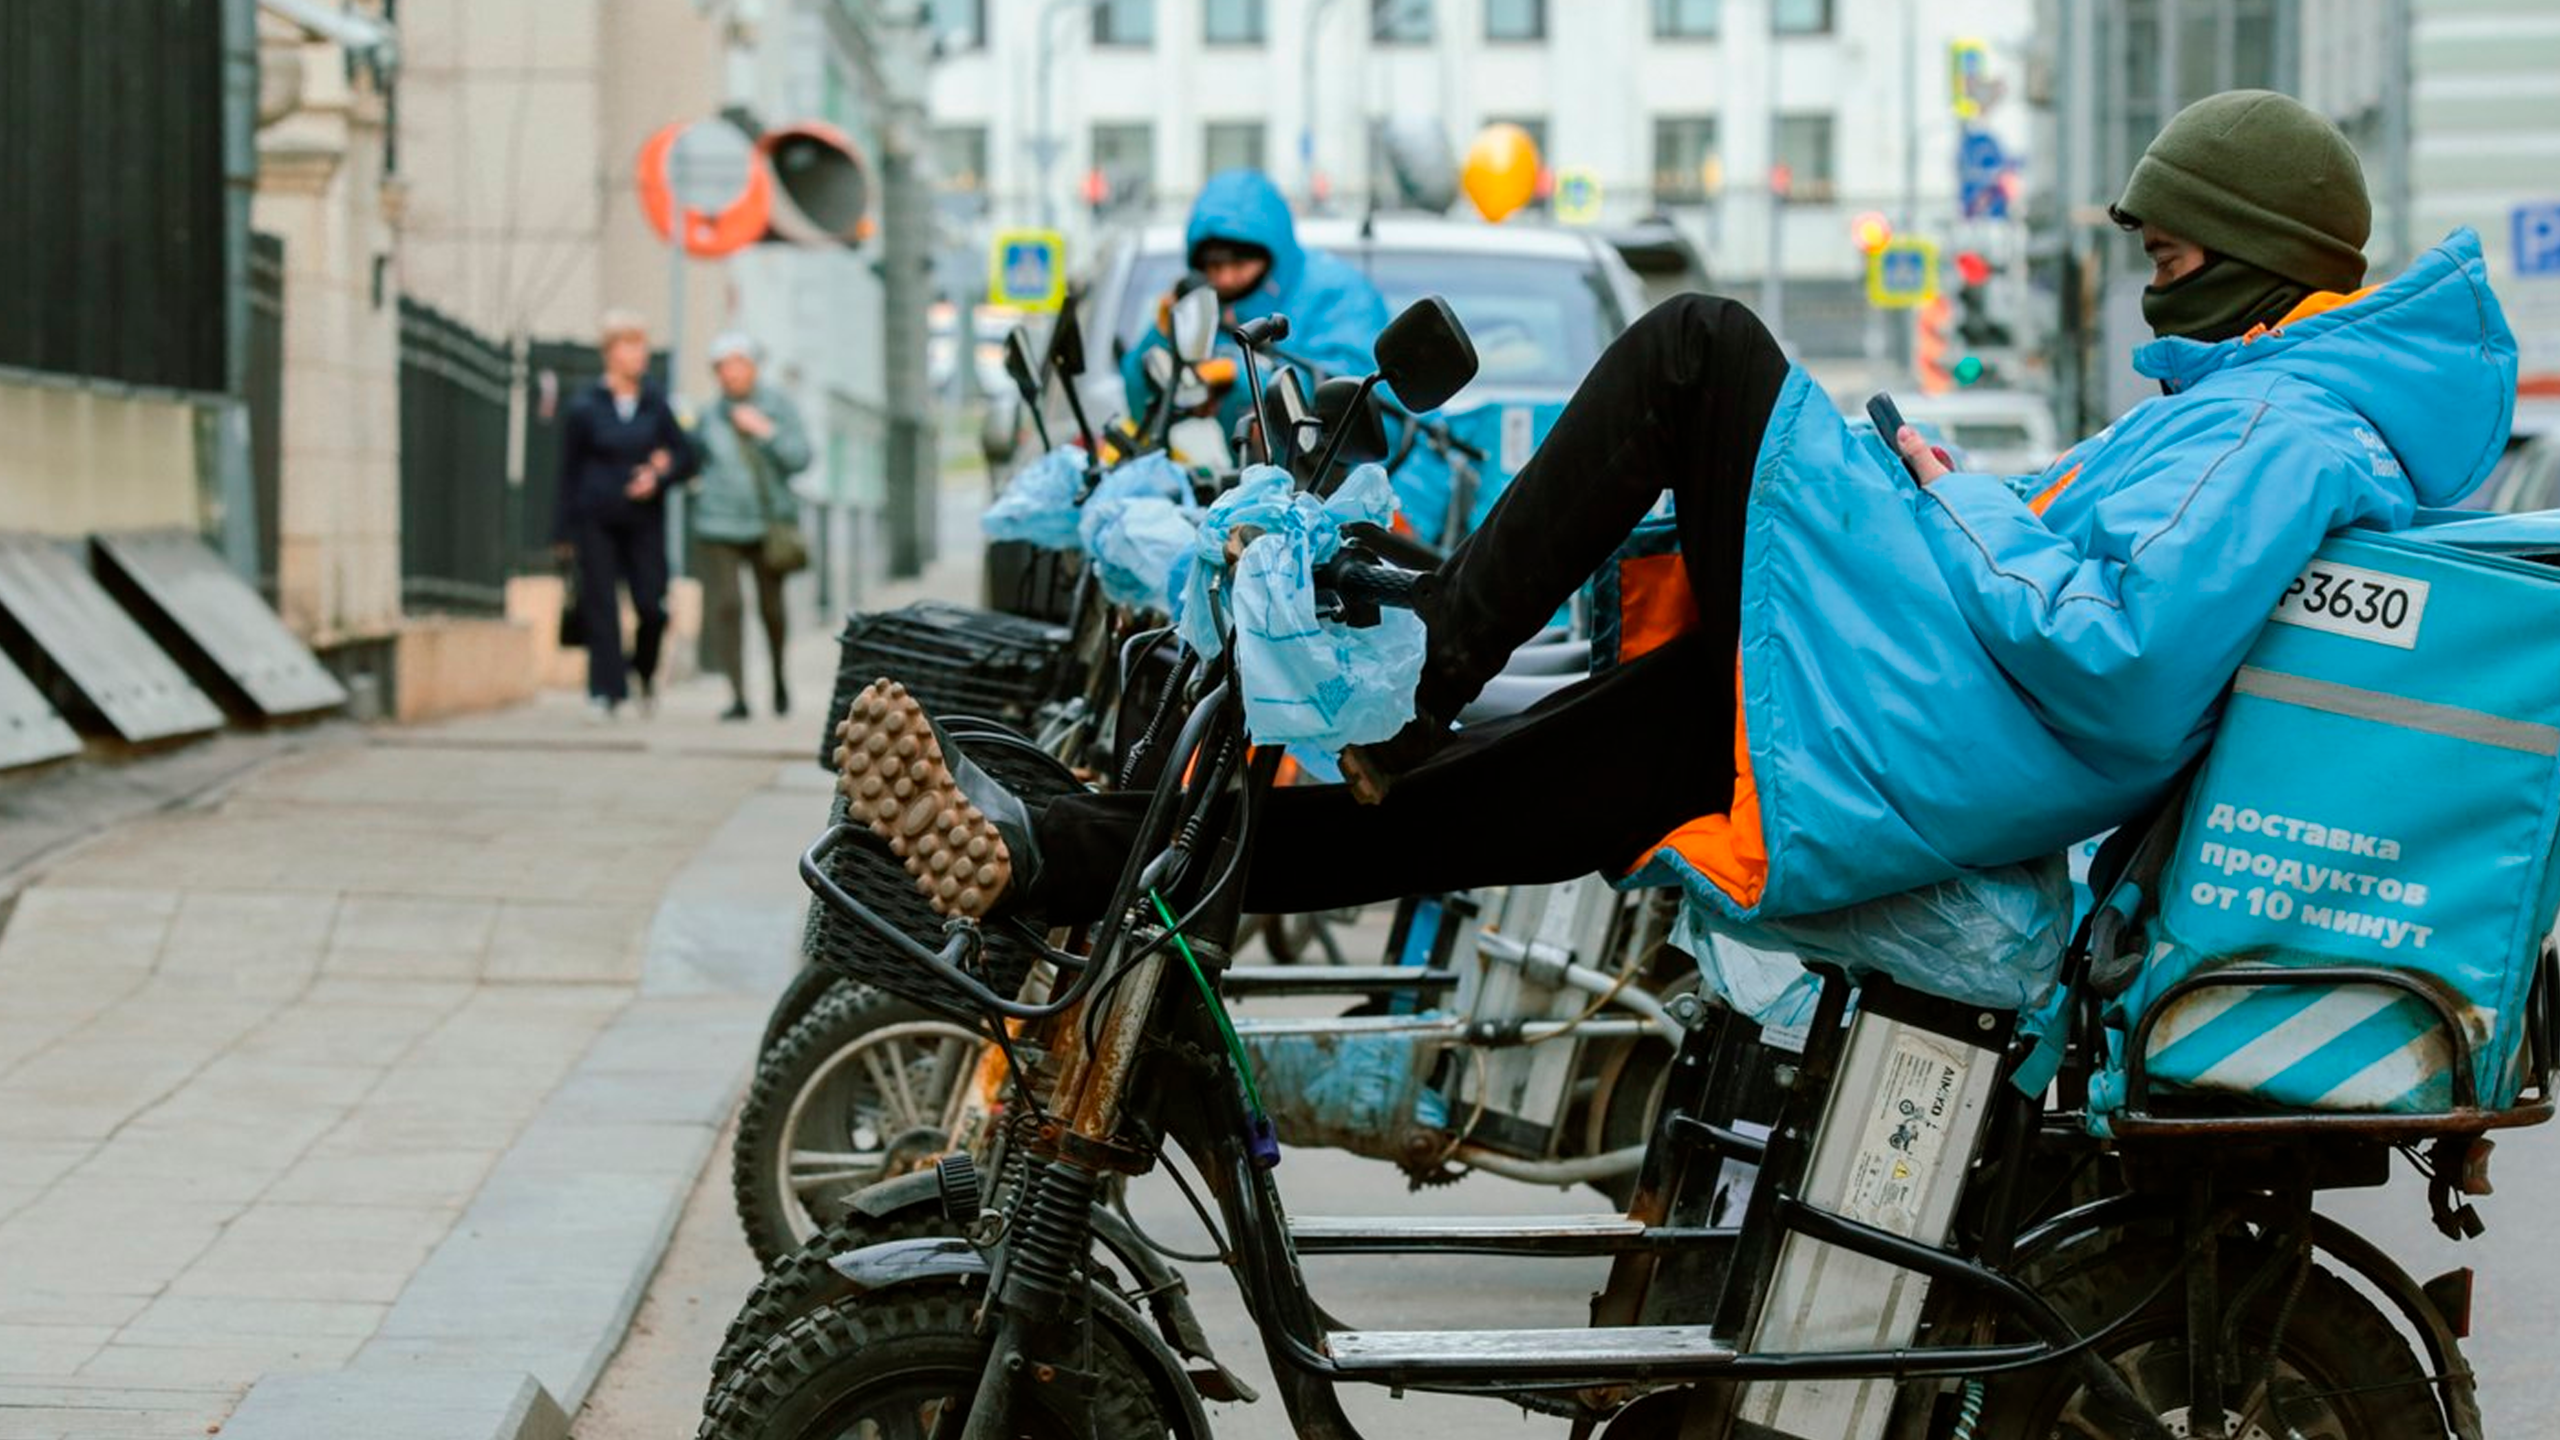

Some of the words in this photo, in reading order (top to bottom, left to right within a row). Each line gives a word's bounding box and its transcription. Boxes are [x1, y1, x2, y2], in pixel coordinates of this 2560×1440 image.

[2206, 803, 2401, 860] доставка
[2200, 842, 2429, 907] продуктов
[2191, 882, 2239, 911] от
[2247, 887, 2294, 921] 10
[2301, 904, 2433, 949] минут
